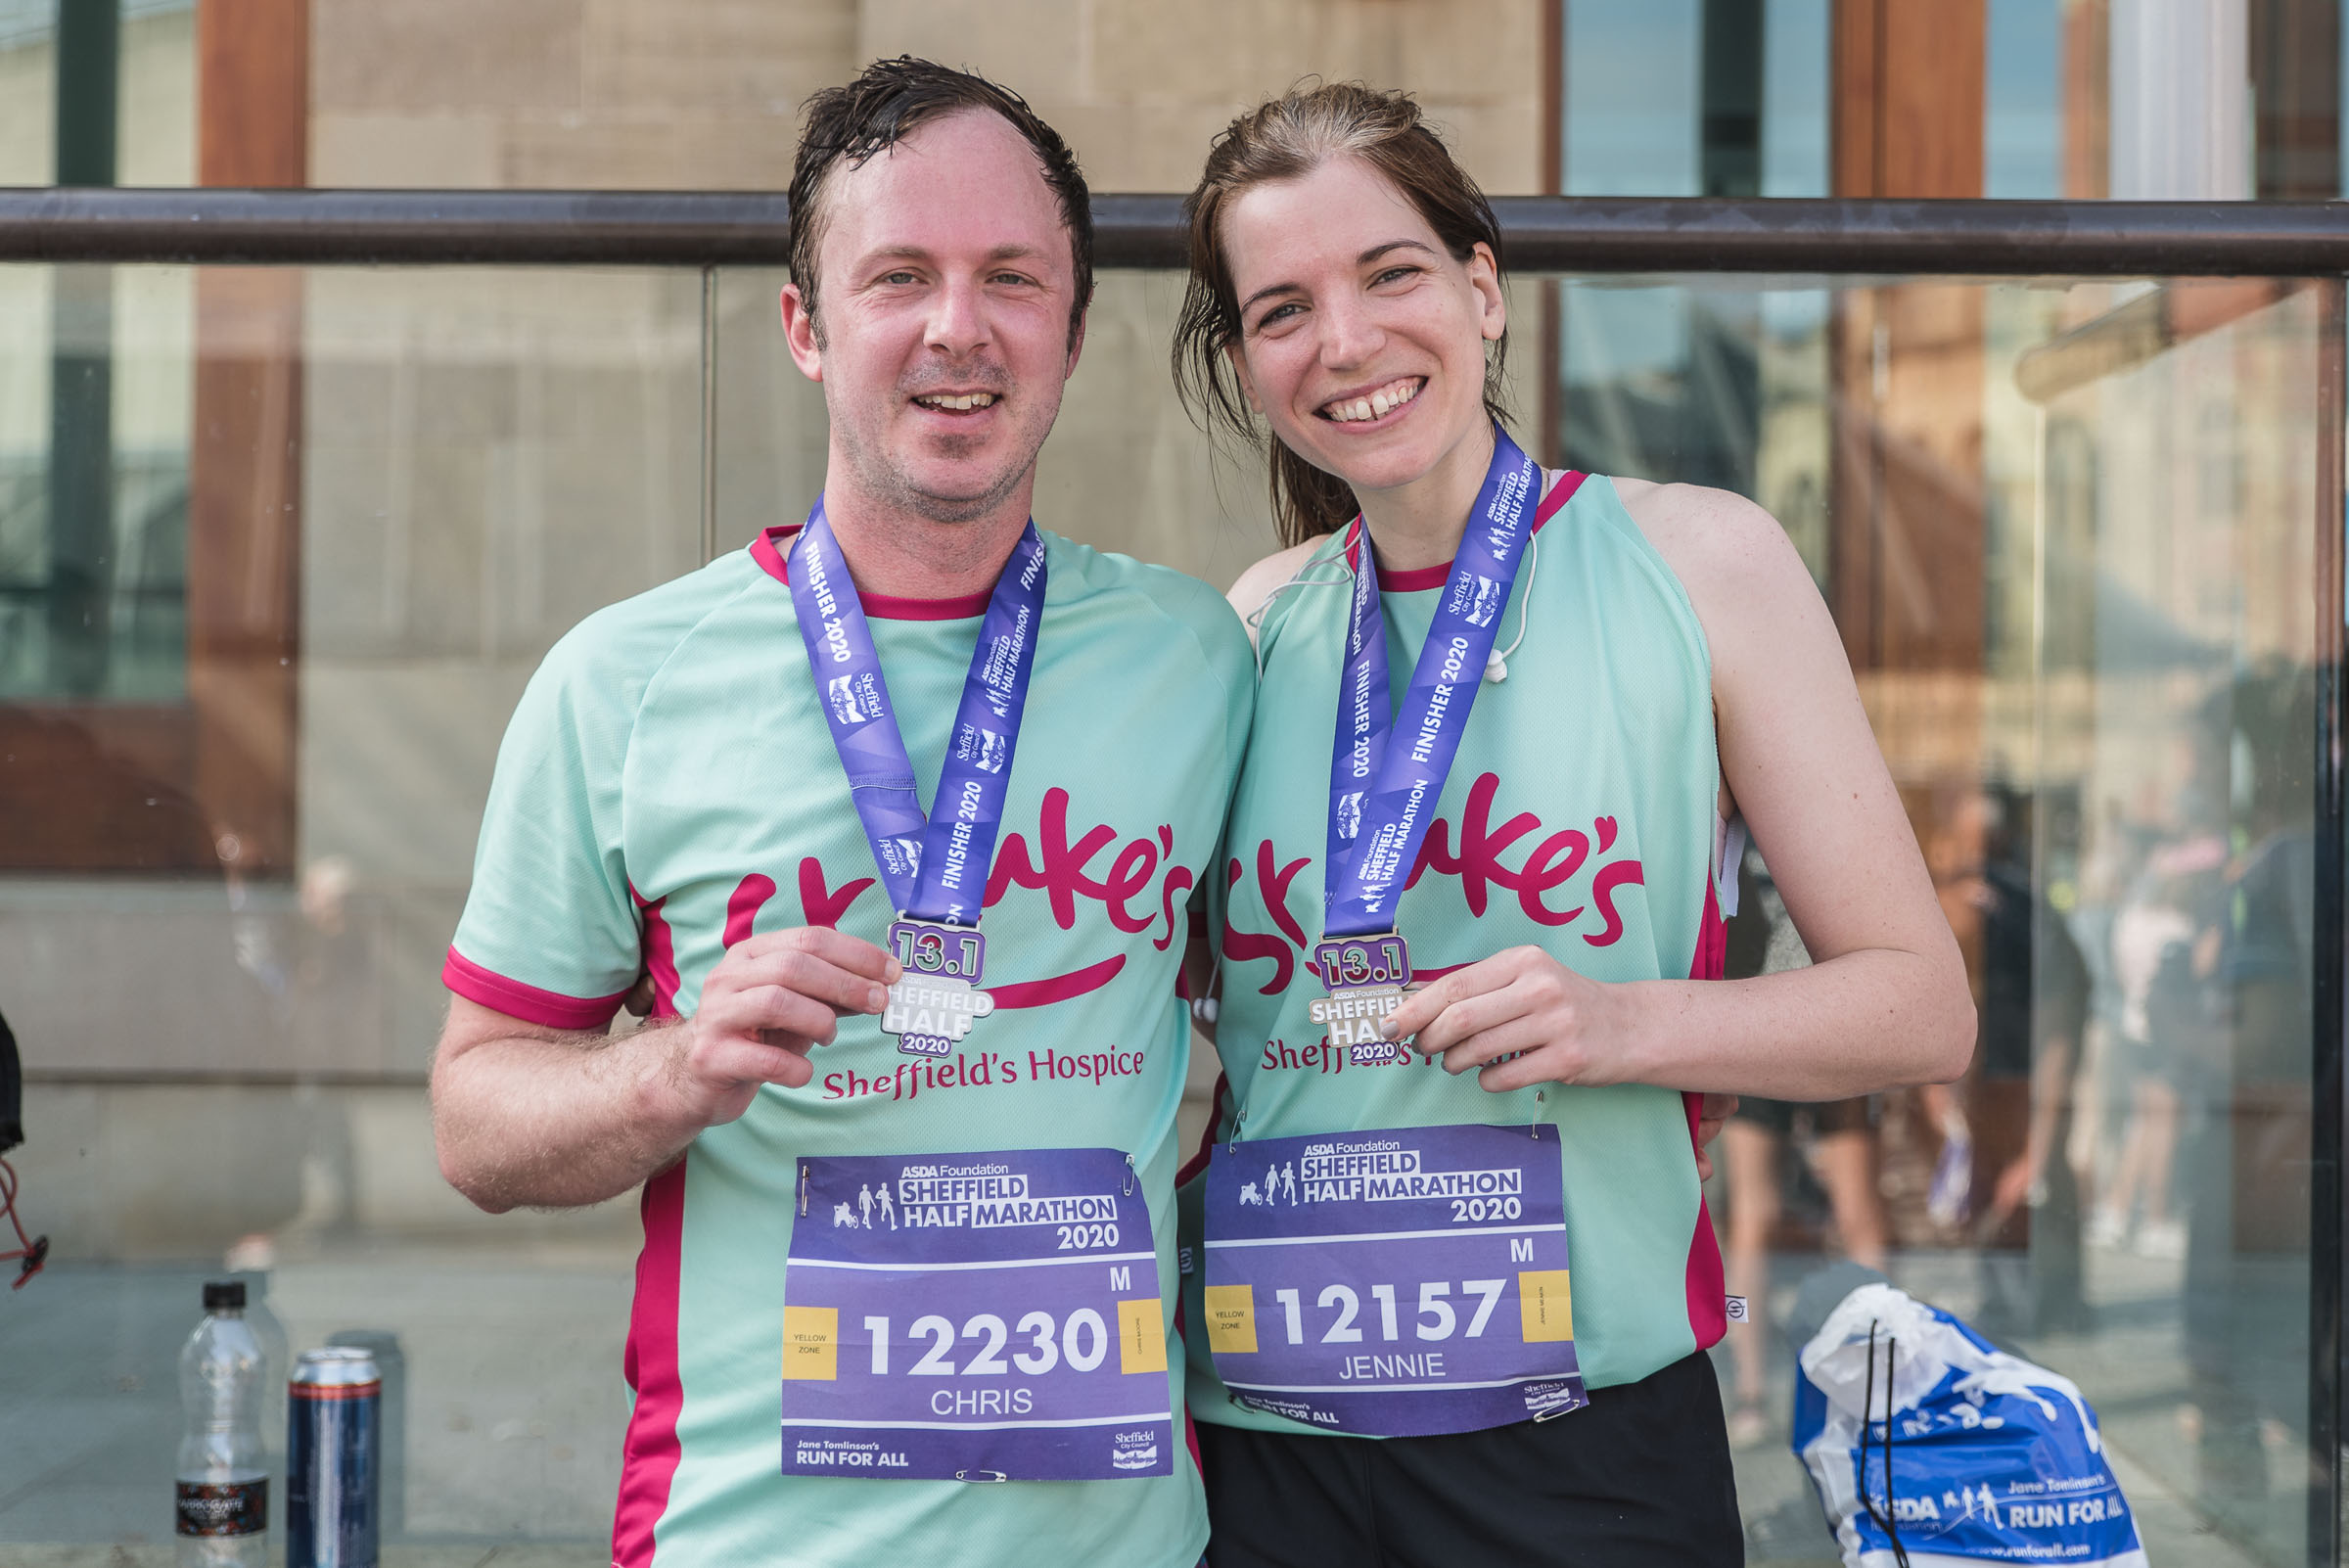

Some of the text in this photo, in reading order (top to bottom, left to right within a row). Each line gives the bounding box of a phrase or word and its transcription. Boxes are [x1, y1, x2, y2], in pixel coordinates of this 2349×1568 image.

[1494, 472, 1518, 525] SHEFFIELD
[1505, 500, 1522, 530] HALF
[805, 540, 852, 664] FINISHER 2020
[1448, 571, 1472, 616] Sheffield
[989, 634, 1011, 687] SHEFFIELD
[1000, 604, 1031, 694] HALF MARATHON
[860, 672, 884, 719] Sheffield
[1411, 636, 1469, 763] FINISHER 2020
[1353, 659, 1370, 779] FINISHER 2020
[956, 723, 975, 762] Sheffield
[942, 821, 973, 890] FINISHER
[958, 780, 982, 822] 2020
[1380, 779, 1429, 881] HALF MARATHON
[878, 839, 902, 875] Sheffield
[1364, 829, 1382, 863] Foundation
[1366, 823, 1397, 881] SHEFFIELD
[896, 930, 979, 977] 13.1
[1321, 943, 1404, 987] 13.1
[889, 986, 990, 1015] HEFFIELD
[1333, 988, 1400, 1000] ASDA Foundation
[887, 1005, 970, 1038] HALF
[1312, 996, 1404, 1022] SHEFFIE
[903, 1035, 949, 1054] 2020
[1330, 1017, 1387, 1045] HA
[1352, 1042, 1396, 1061] 2020
[823, 1044, 1144, 1102] Sheffield's Hospice
[1304, 1139, 1401, 1157] ASDA Foundation
[900, 1164, 1009, 1178] ASDA Foundation
[1304, 1153, 1417, 1179] SHEFFIELD
[902, 1176, 1025, 1203] SHEFFIELD
[1304, 1172, 1519, 1203] HALF MARATHON
[903, 1197, 1115, 1227] HALF MARATHON
[1451, 1197, 1522, 1222] 2020
[1057, 1223, 1120, 1250] 2020
[1510, 1238, 1535, 1263] M
[1109, 1266, 1131, 1292] M
[1215, 1311, 1245, 1319] YELLOW
[1275, 1278, 1508, 1345] 12157
[794, 1333, 827, 1344] YELLOW
[1221, 1322, 1241, 1331] ZONE
[798, 1345, 821, 1355] ZONE
[863, 1308, 1108, 1376] 12230
[1339, 1353, 1447, 1380] JENNIE
[930, 1388, 1033, 1416] CHRIS
[1279, 1407, 1340, 1424] FOR ALL
[797, 1440, 880, 1451] Jane Tomlinson's
[1115, 1430, 1154, 1444] Sheffield
[797, 1452, 909, 1467] RUN FOR ALL
[2008, 1480, 2045, 1495] Jane
[2009, 1496, 2125, 1529] RUN FOR ALL
